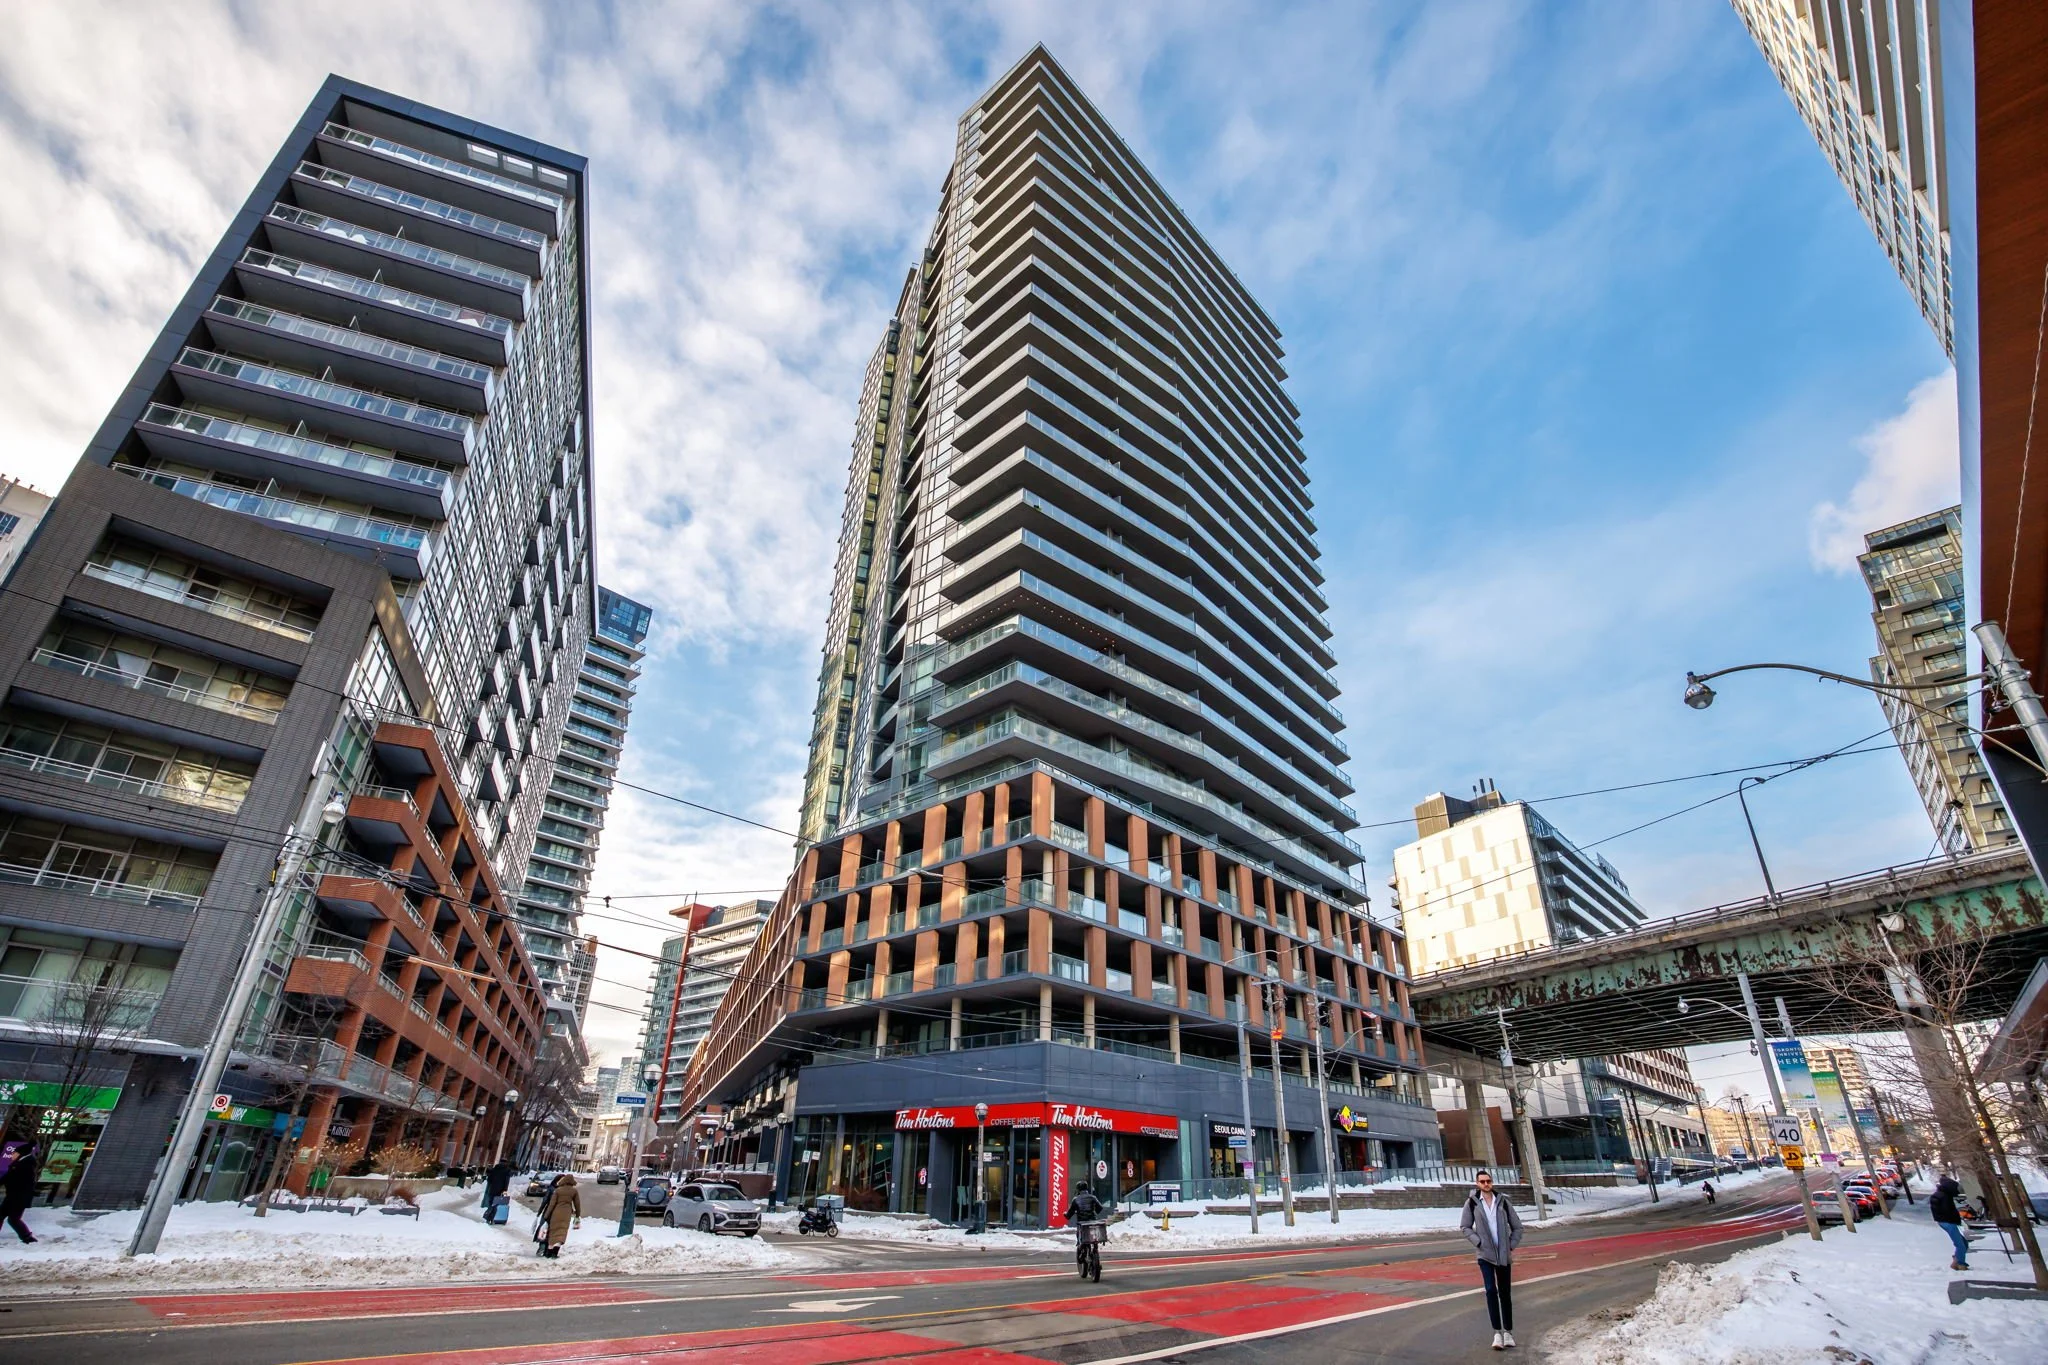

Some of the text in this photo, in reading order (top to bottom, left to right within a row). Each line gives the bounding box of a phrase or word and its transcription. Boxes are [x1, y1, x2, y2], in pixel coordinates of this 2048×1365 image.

[1777, 1057, 1806, 1065] HERE
[895, 1108, 955, 1129] Tim Hortons
[990, 1116, 1041, 1126] COFFEE HOUSE
[1052, 1105, 1113, 1130] Tim Hortons
[1214, 1124, 1231, 1135] SEOUL
[1778, 1128, 1800, 1141] 40
[1052, 1135, 1065, 1217] Tim Hortons
